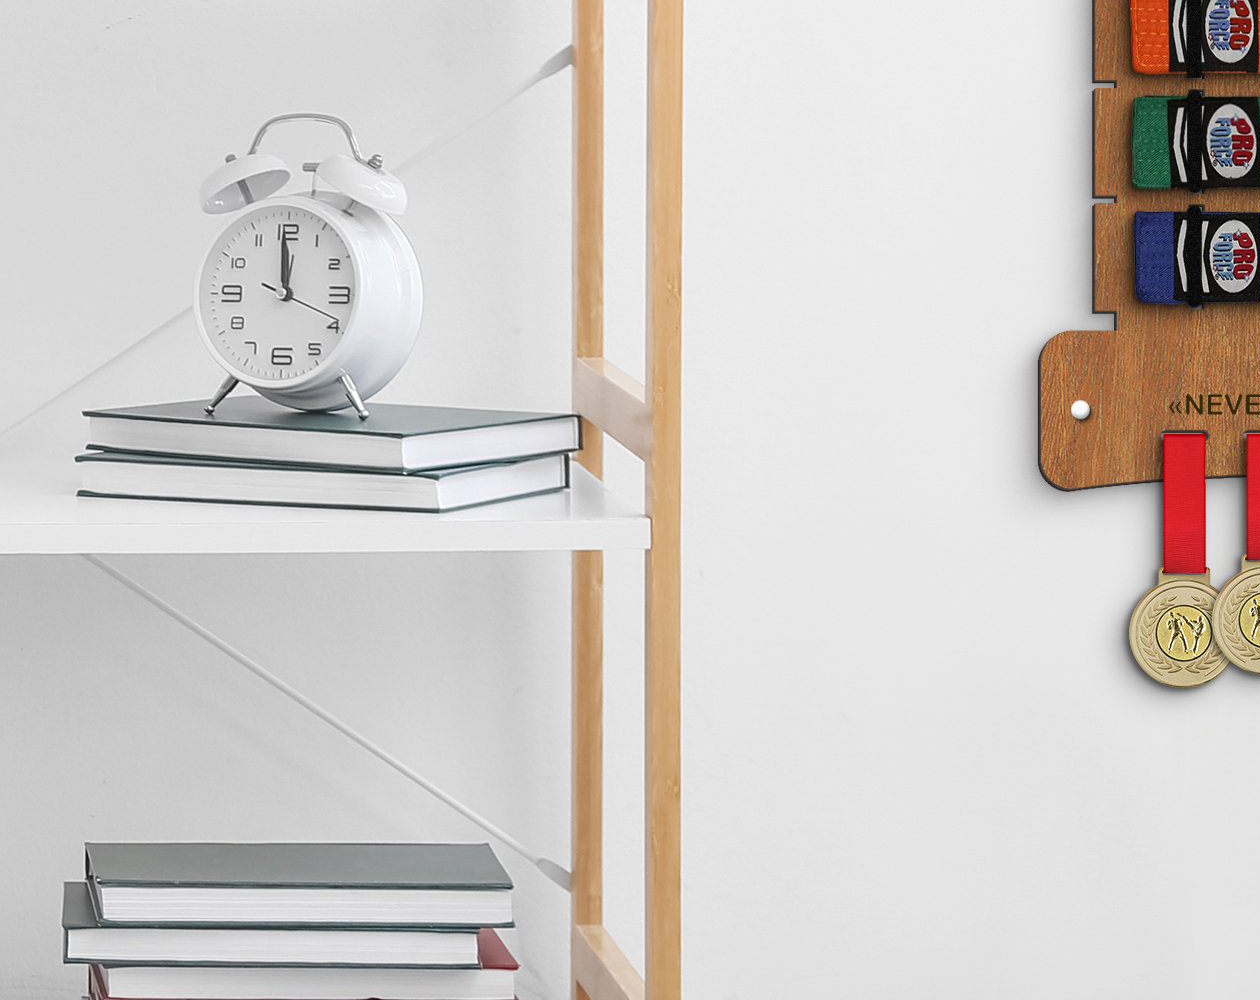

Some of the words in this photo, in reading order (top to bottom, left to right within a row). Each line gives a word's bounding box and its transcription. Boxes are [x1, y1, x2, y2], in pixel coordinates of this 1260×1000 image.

[1208, 0, 1230, 50] FORCE
[1229, 0, 1252, 50] PRO
[1210, 117, 1233, 167] FORCE
[1230, 117, 1254, 166] PRO
[277, 223, 300, 240] 12
[255, 234, 263, 247] 11
[314, 234, 319, 247] 1
[231, 257, 246, 269] 10
[328, 258, 341, 270] 2
[1213, 232, 1234, 281] FORCE
[1232, 232, 1256, 280] PRO
[221, 285, 243, 302] 9
[328, 286, 351, 304] 3
[231, 316, 245, 329] 8
[326, 320, 340, 333] 4
[244, 341, 257, 355] 7
[271, 347, 294, 365] 6
[308, 343, 322, 356] 5
